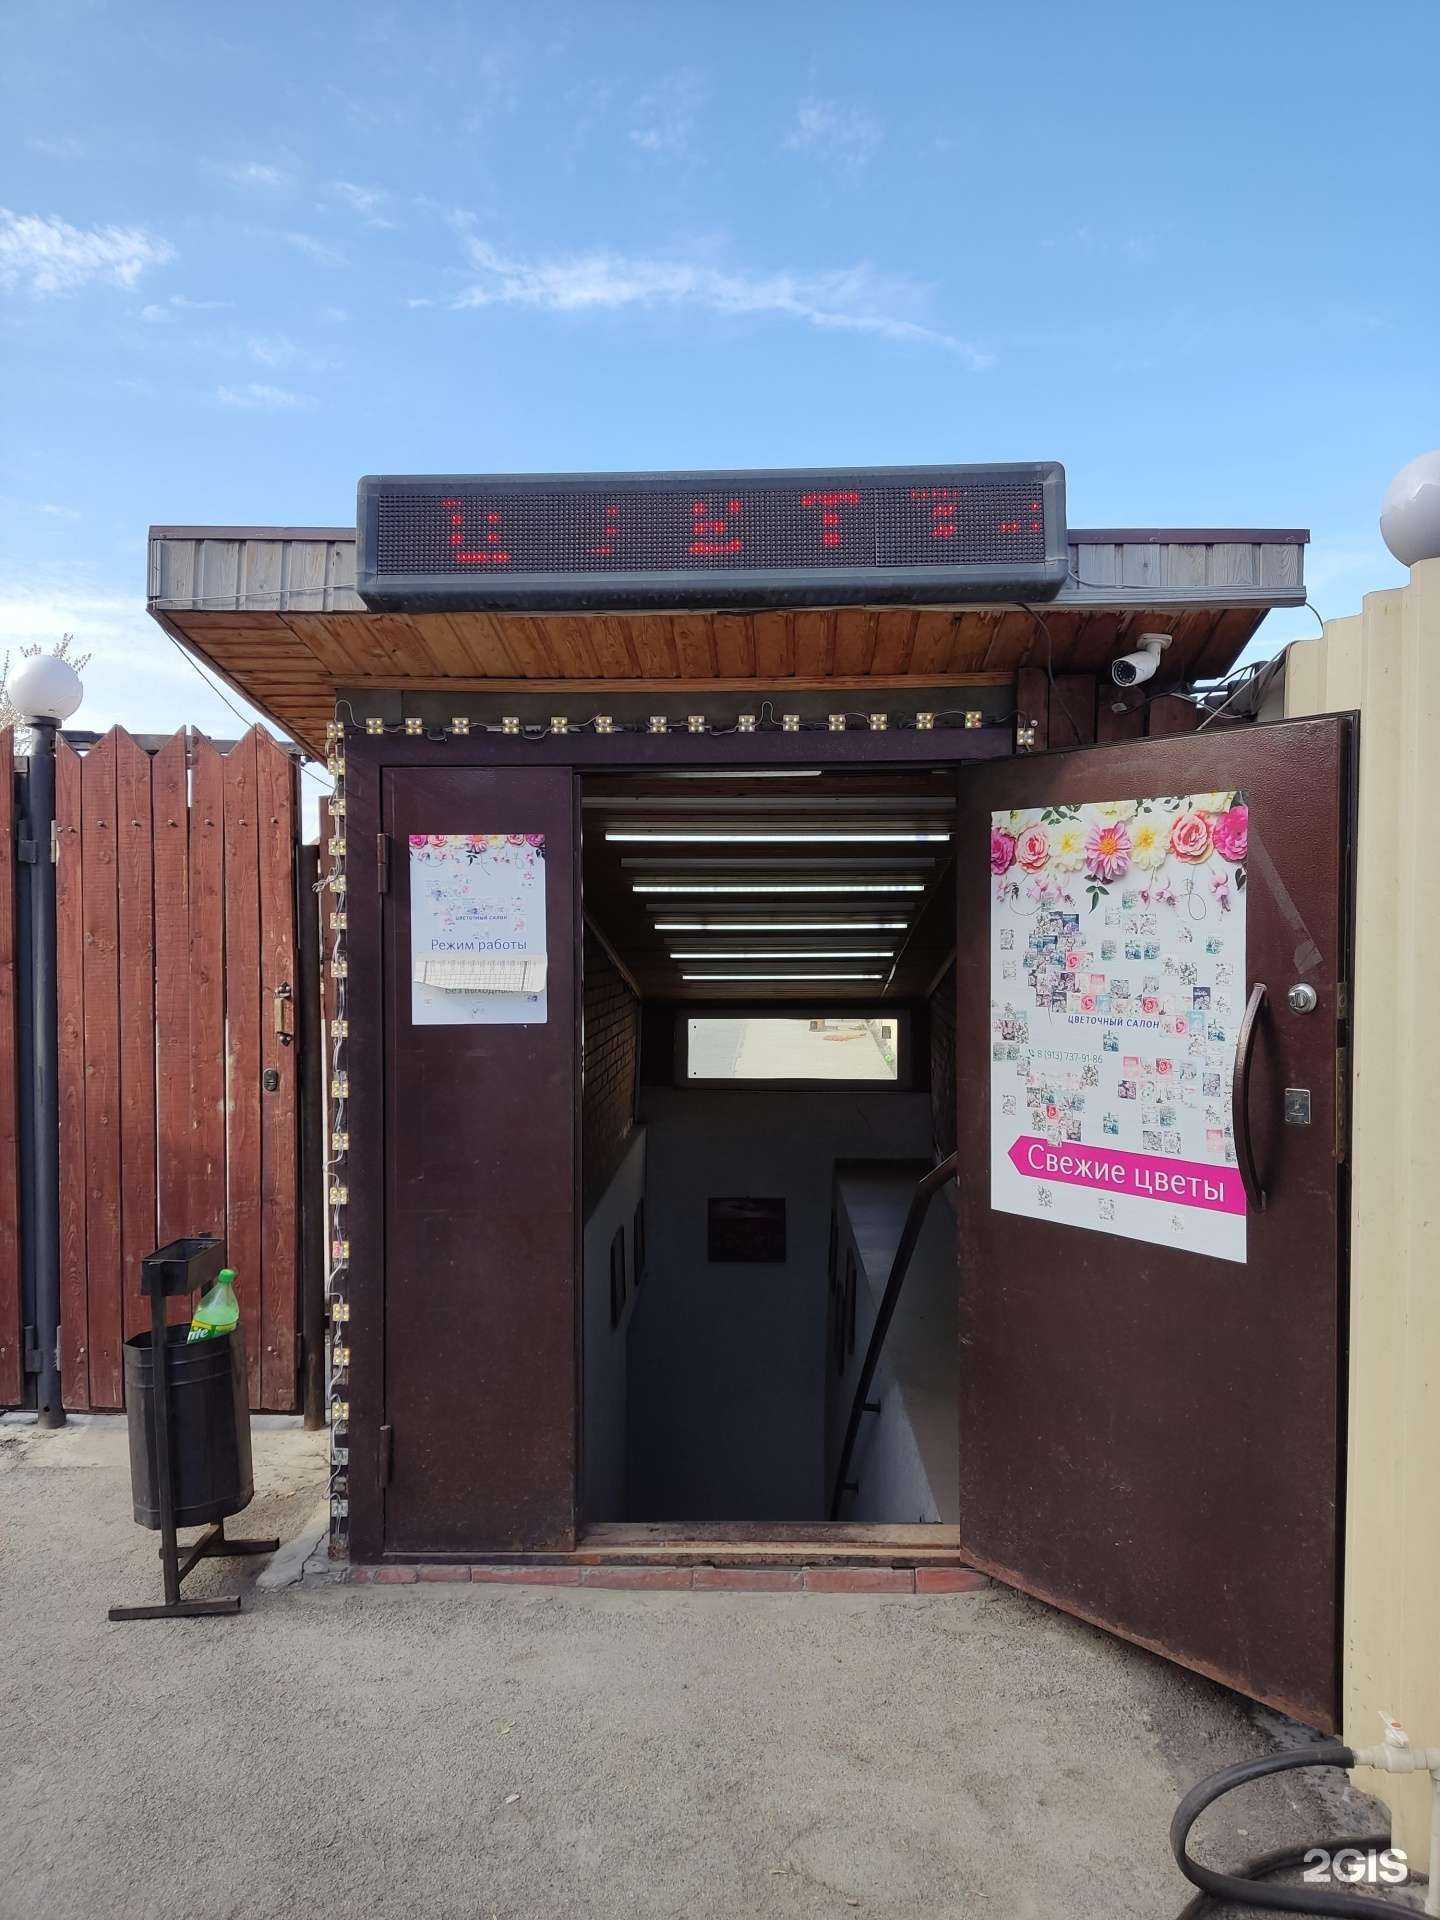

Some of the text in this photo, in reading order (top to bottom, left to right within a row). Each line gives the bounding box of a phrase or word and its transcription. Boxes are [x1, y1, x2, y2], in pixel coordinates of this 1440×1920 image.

[431, 938, 527, 953] Режим работы
[1067, 1015, 1160, 1029] ЦВЕТОЧНЫЙ САЛОН
[1027, 1144, 1224, 1202] Свежие цветы
